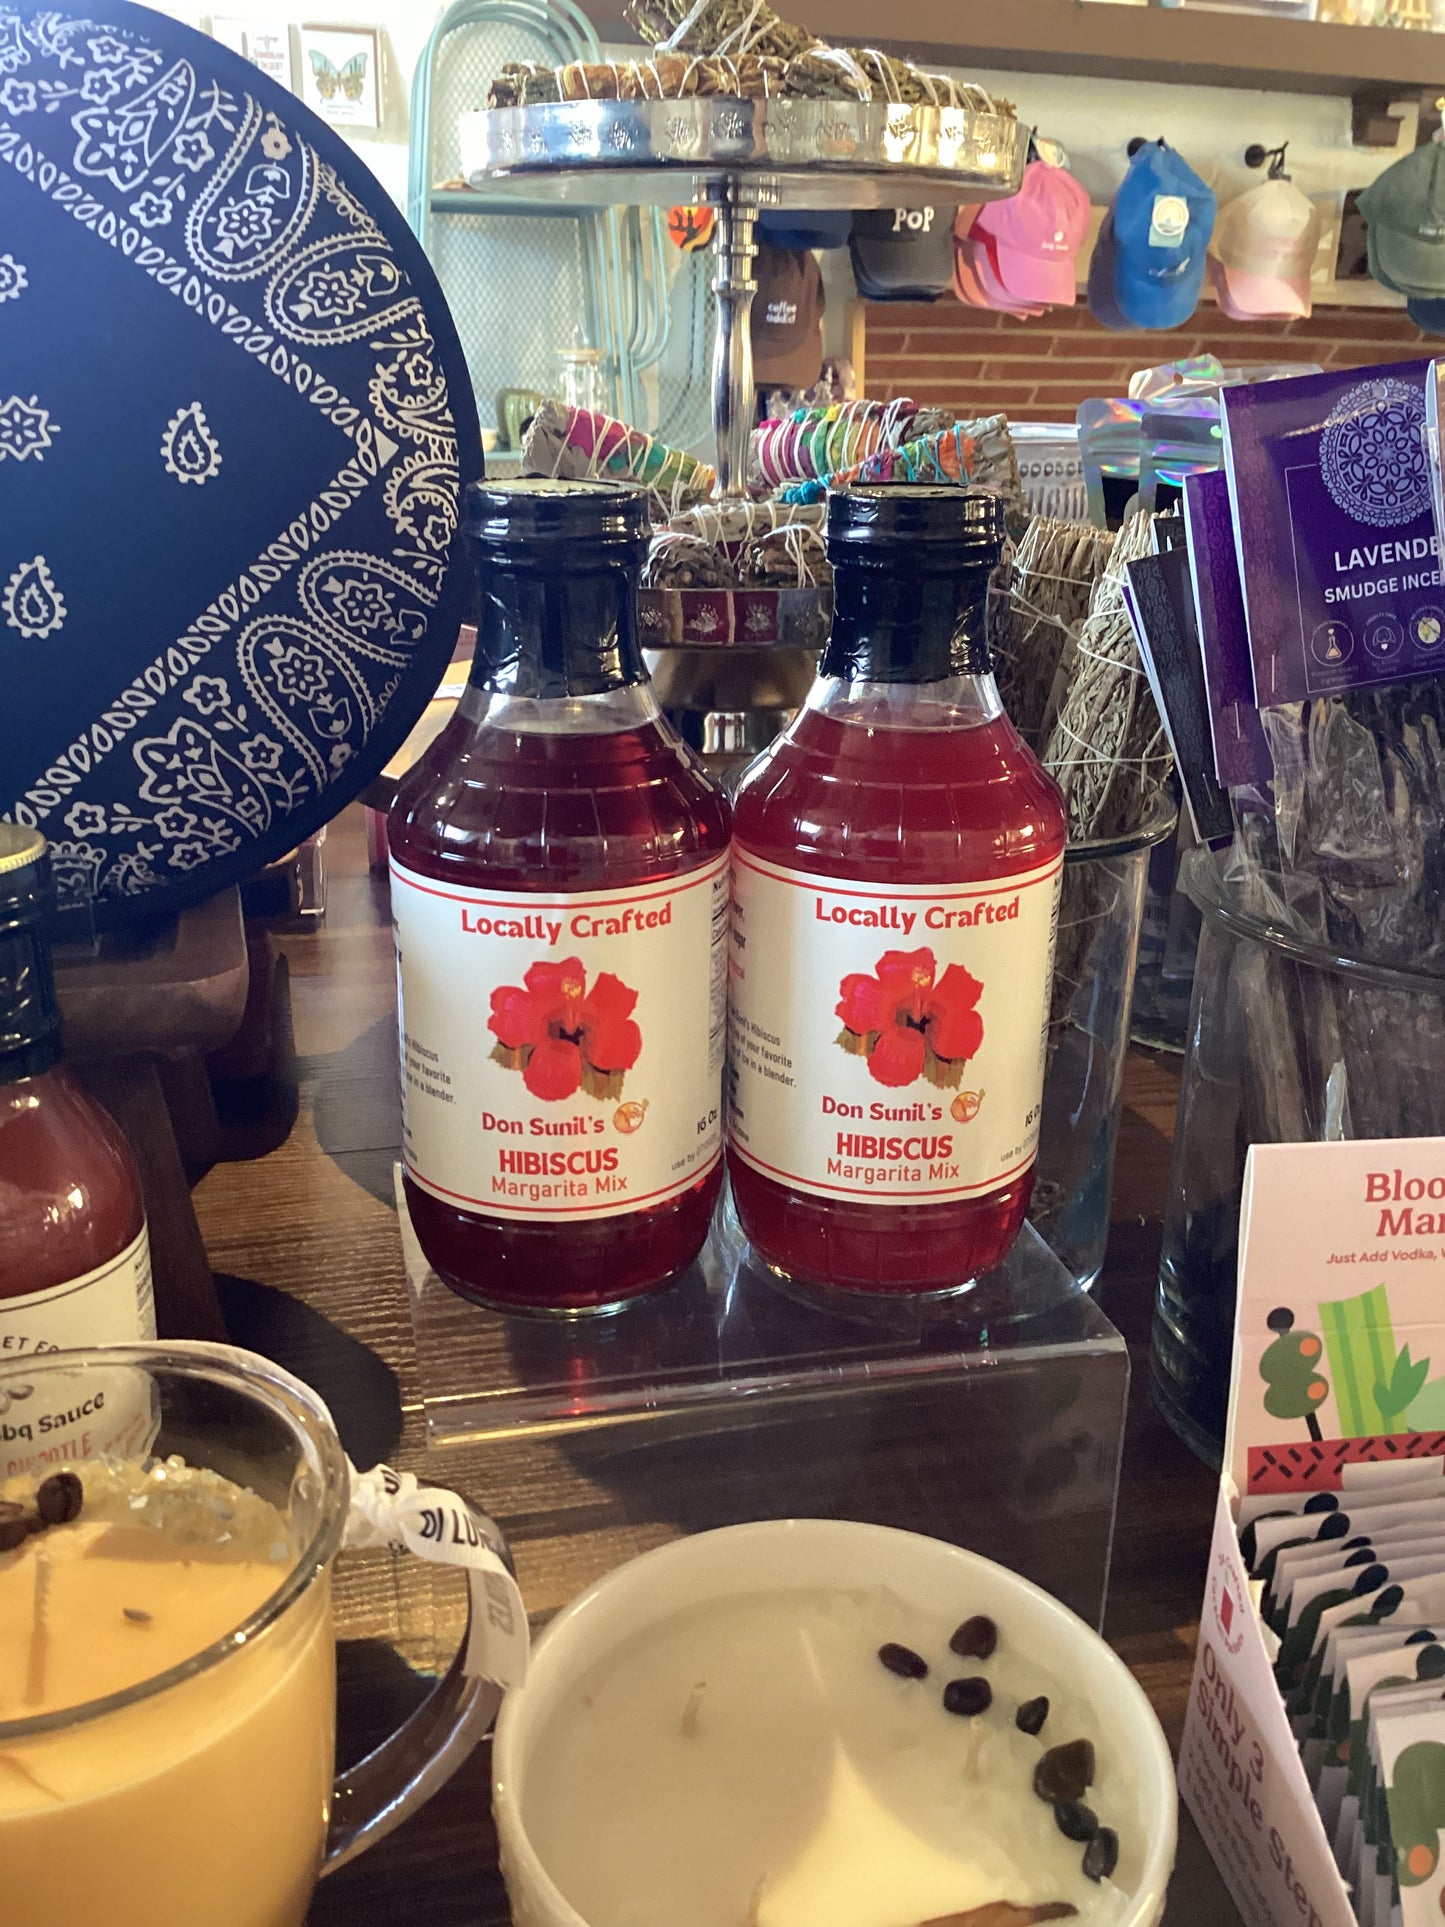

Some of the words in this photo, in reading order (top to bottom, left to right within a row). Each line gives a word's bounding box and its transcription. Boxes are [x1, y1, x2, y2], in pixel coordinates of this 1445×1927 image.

[1324, 577, 1399, 604] SMUDGE
[461, 909, 562, 946] Locally
[570, 901, 672, 938] Crafted
[816, 897, 917, 935] Locally
[924, 895, 1020, 929] Crafted
[761, 1046, 793, 1068] favorite
[763, 1063, 798, 1088] blender.
[822, 1095, 864, 1119] Don
[869, 1102, 943, 1122] Sunil's
[1025, 1110, 1033, 1128] 16
[482, 1112, 524, 1135] Don
[529, 1116, 605, 1136] Sunil's
[696, 1117, 707, 1135] 16
[836, 1132, 954, 1160] HIBISCUS
[499, 1147, 619, 1176] HIBISCUS
[827, 1157, 921, 1185] Margarita
[929, 1162, 960, 1181] Mix
[491, 1175, 588, 1201] Margarita
[595, 1174, 628, 1195] Mix
[1365, 1168, 1445, 1203] Bloo
[1326, 1251, 1356, 1264] Just
[1359, 1249, 1388, 1263] Add
[1392, 1247, 1437, 1261] Vodka,
[0, 1424, 33, 1442] bq
[38, 1392, 104, 1434] Sauce
[1203, 1642, 1246, 1746] Only
[1250, 1740, 1264, 1784] 3
[1197, 1679, 1263, 1831] Simple
